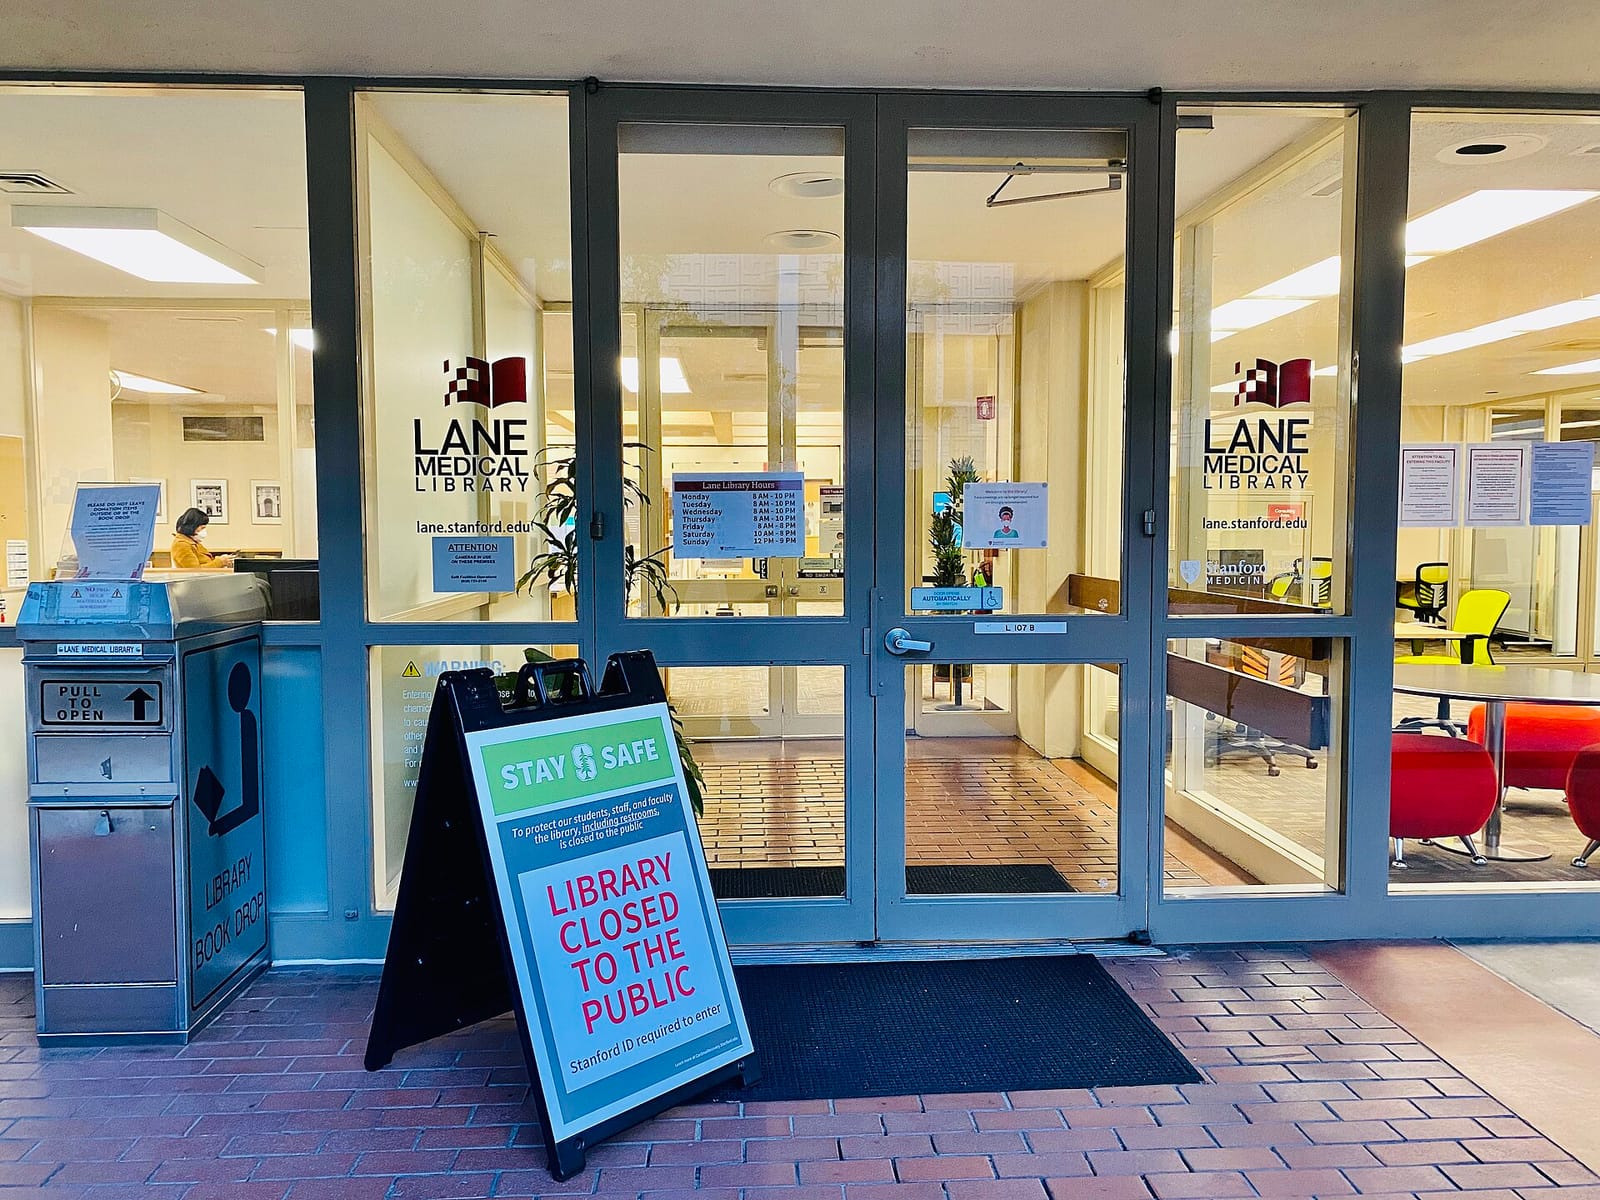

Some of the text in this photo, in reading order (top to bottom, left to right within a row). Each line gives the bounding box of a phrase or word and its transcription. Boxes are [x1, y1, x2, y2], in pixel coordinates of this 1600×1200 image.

[414, 418, 528, 455] LANE
[1204, 419, 1309, 453] LANE
[415, 456, 529, 476] MEDICAL
[1204, 455, 1308, 474] MEDICAL
[416, 477, 528, 492] LIBRARY
[722, 481, 750, 491] Library
[751, 481, 775, 489] Hours
[1204, 475, 1308, 488] LIBRARY
[416, 520, 530, 533] lane.stanford.edu
[1203, 517, 1308, 529] lane.stanford.edu
[448, 544, 498, 552] ATTENTION
[1206, 560, 1266, 575] Stanford
[59, 686, 102, 698] PULL
[403, 690, 432, 700] Entering
[68, 698, 92, 709] TO
[57, 710, 104, 721] OPEN
[405, 745, 417, 754] and
[405, 759, 416, 768] For
[501, 754, 566, 790] STAY
[601, 738, 658, 770] SAFE
[512, 792, 674, 838] To protect our students, staff, and faculty
[534, 808, 660, 844] the library, including restrooms,
[560, 821, 643, 850] is closed to the public
[206, 852, 252, 911] LIBRARY
[546, 852, 672, 917] LIBRARY
[196, 892, 264, 970] BOOK DROP
[559, 892, 680, 954] CLOSED
[571, 928, 686, 992] TO THE
[582, 965, 696, 1034] PUBLIC
[570, 1004, 722, 1074] Stanford ID required to enter
